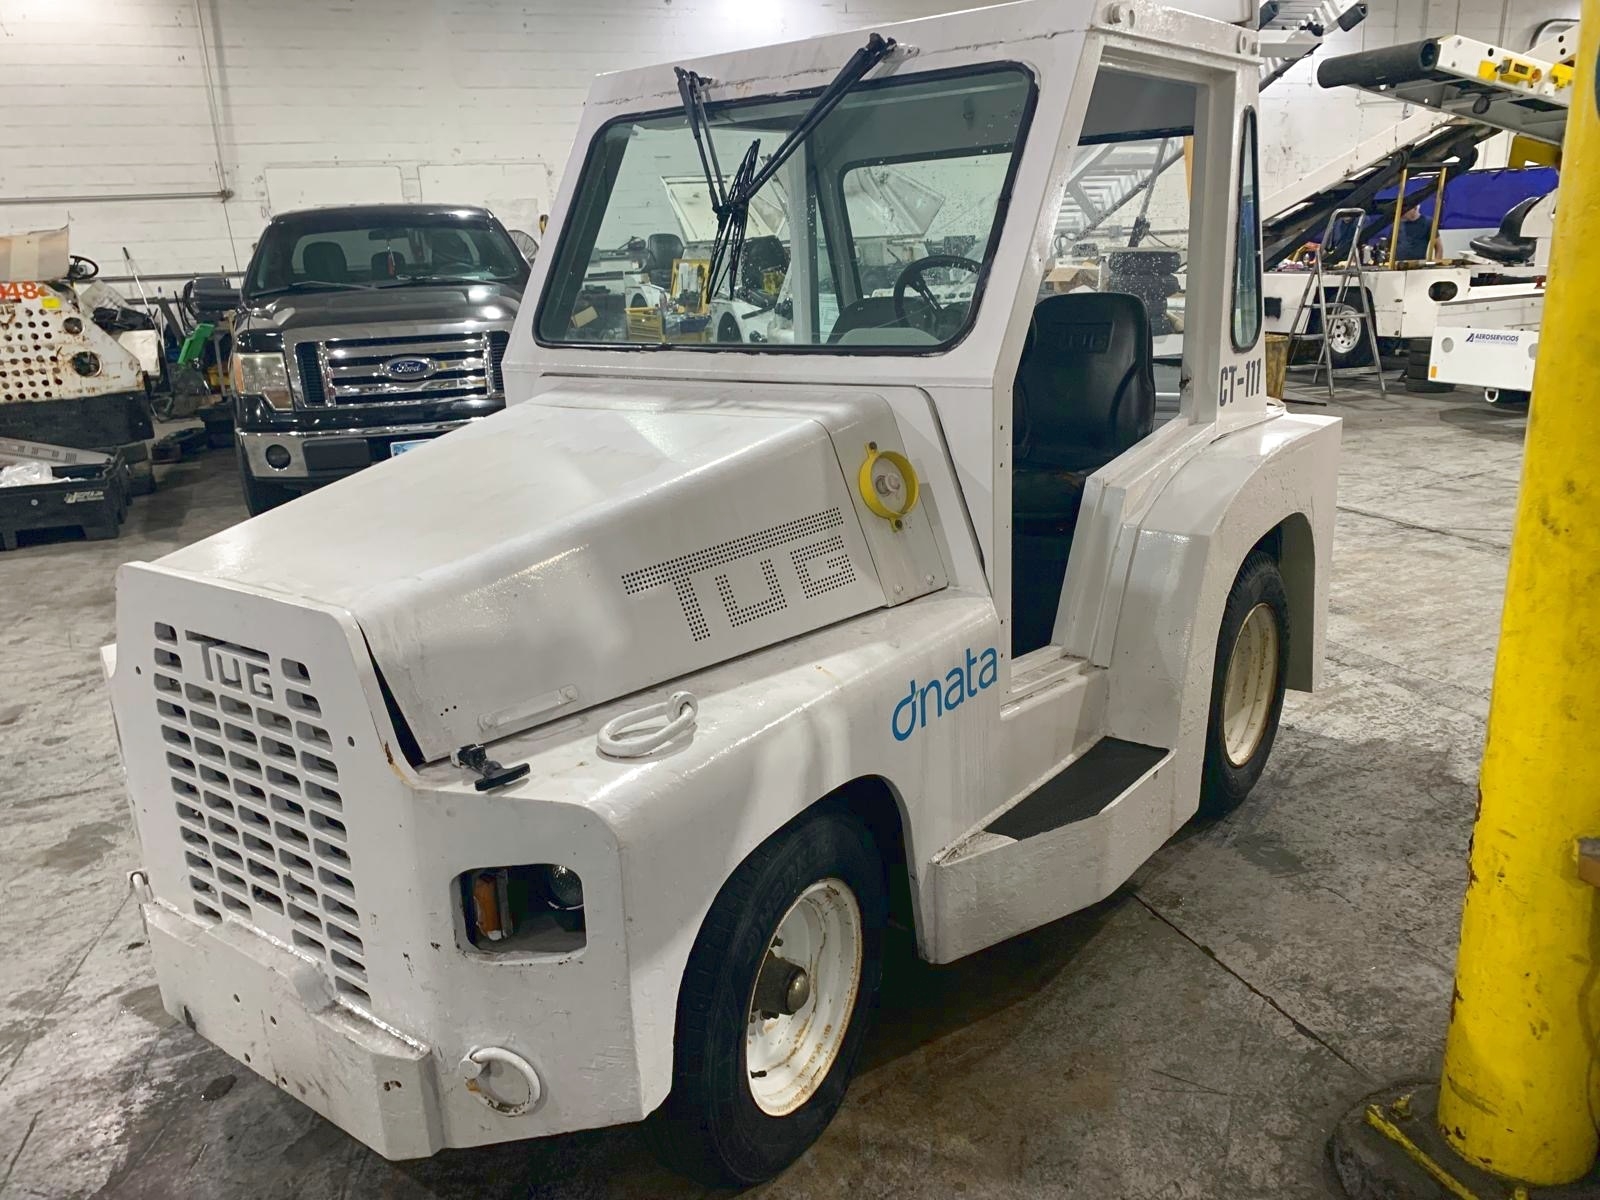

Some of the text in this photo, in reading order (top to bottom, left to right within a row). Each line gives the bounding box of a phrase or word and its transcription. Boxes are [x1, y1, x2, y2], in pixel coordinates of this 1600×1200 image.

[1475, 333, 1519, 342] AEROSERVICIOS
[1220, 358, 1262, 407] CT-111
[621, 507, 857, 642] TUG
[184, 629, 275, 703] TUG
[892, 647, 998, 741] dnata
